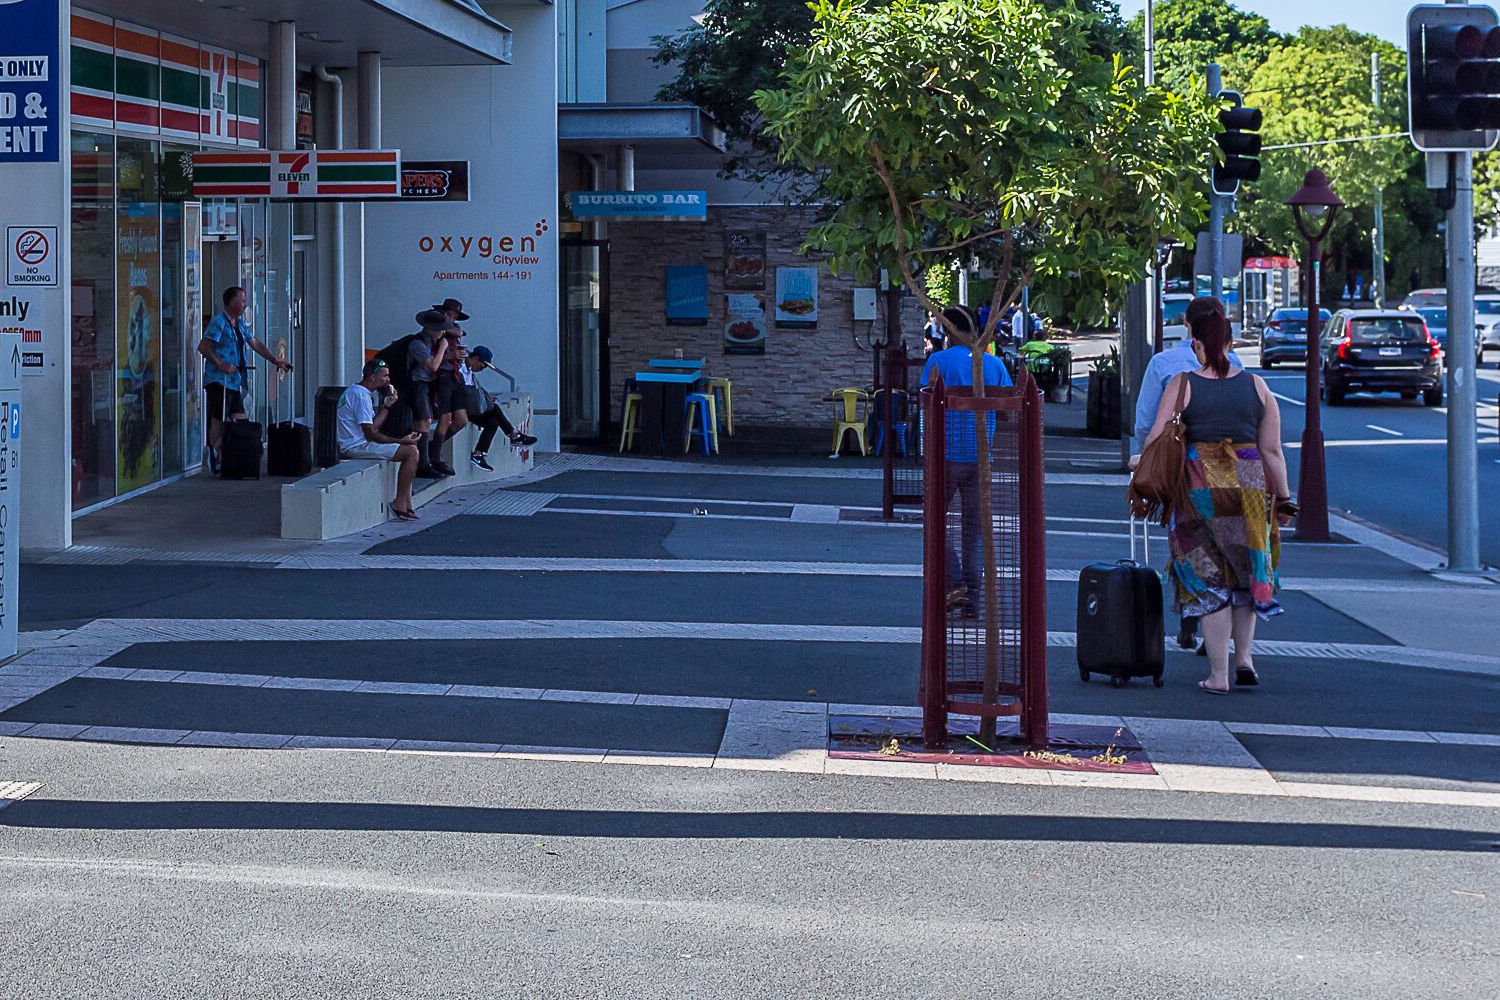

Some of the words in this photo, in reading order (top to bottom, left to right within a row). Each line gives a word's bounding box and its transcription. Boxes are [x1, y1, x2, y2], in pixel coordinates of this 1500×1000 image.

[7, 59, 45, 77] ONLY
[23, 92, 47, 119] &
[578, 194, 658, 205] BURRITO
[662, 194, 700, 205] BAR
[419, 236, 536, 259] oxygen
[493, 254, 540, 266] Cityview
[433, 271, 489, 281] Apartments
[0, 401, 9, 491] Retail
